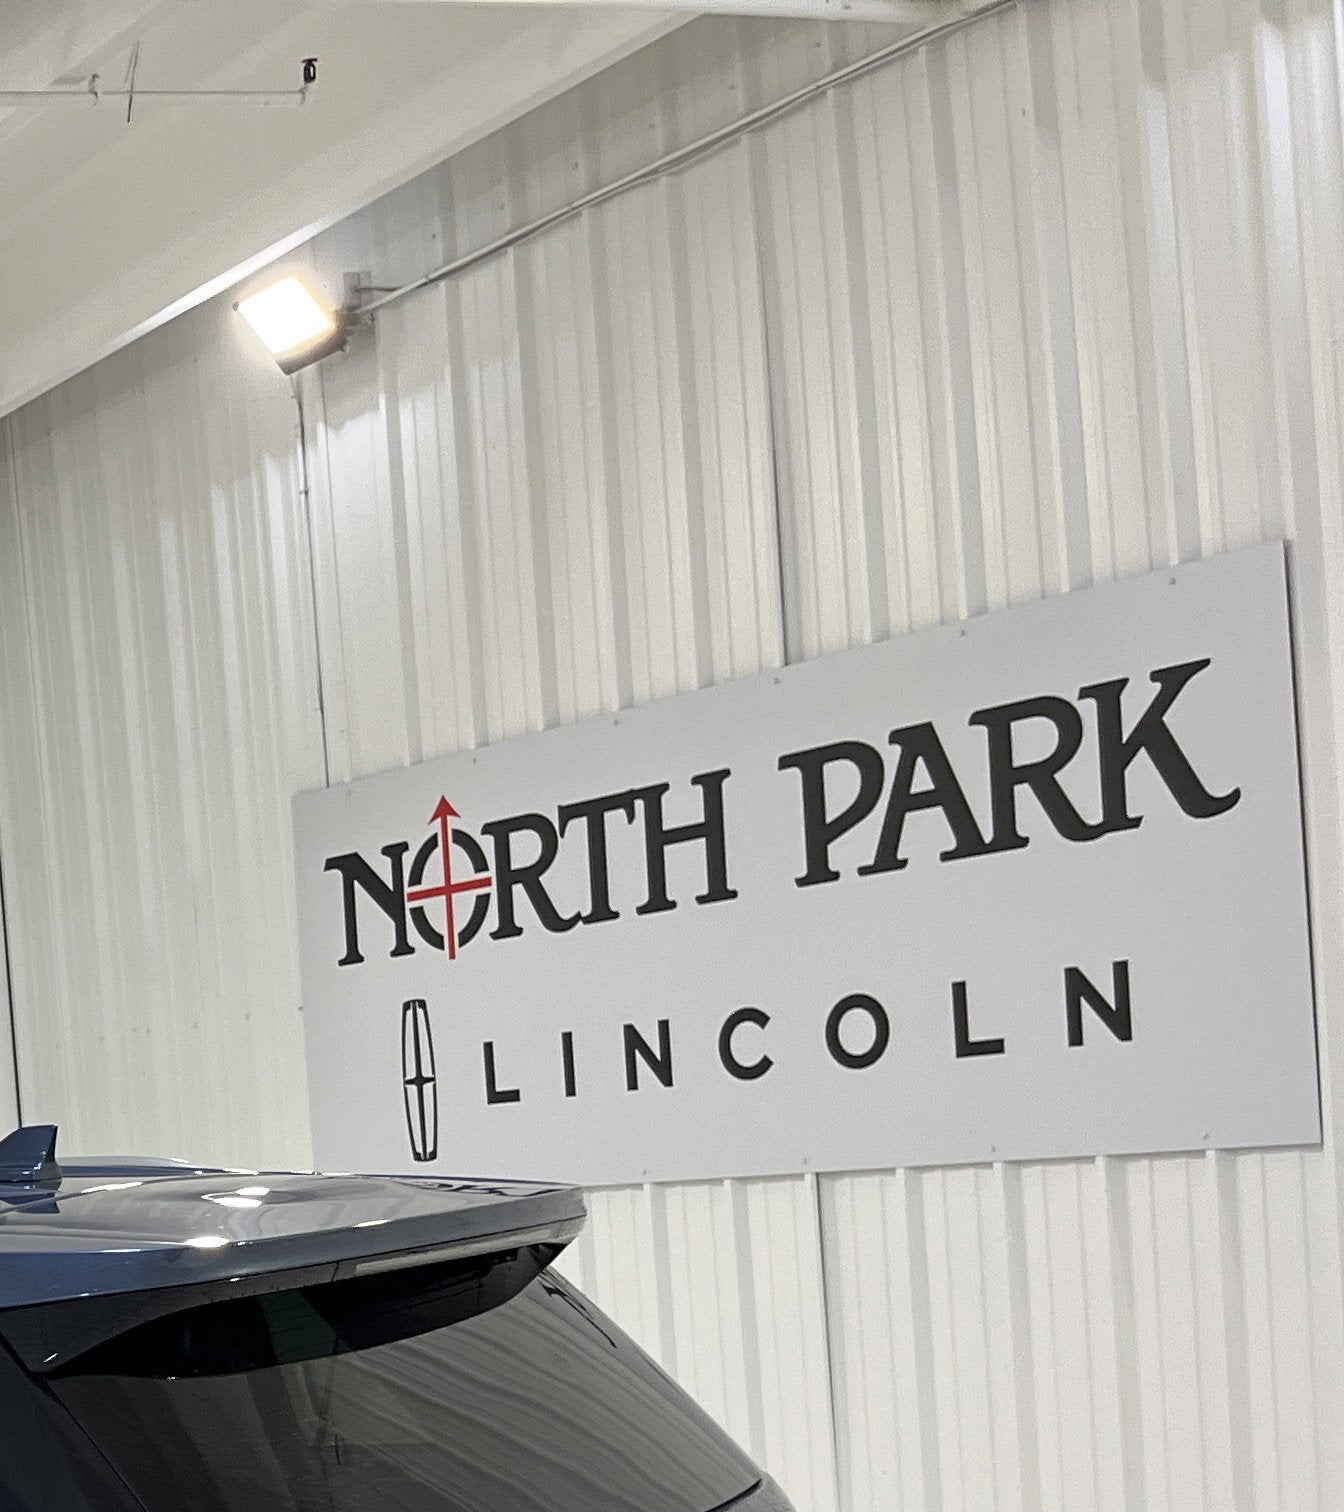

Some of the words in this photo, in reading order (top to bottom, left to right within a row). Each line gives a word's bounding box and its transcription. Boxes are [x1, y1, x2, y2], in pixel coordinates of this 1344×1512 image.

[323, 767, 738, 966] NORTH
[776, 657, 1242, 888] PARK
[482, 958, 1134, 1105] LINCOLN
